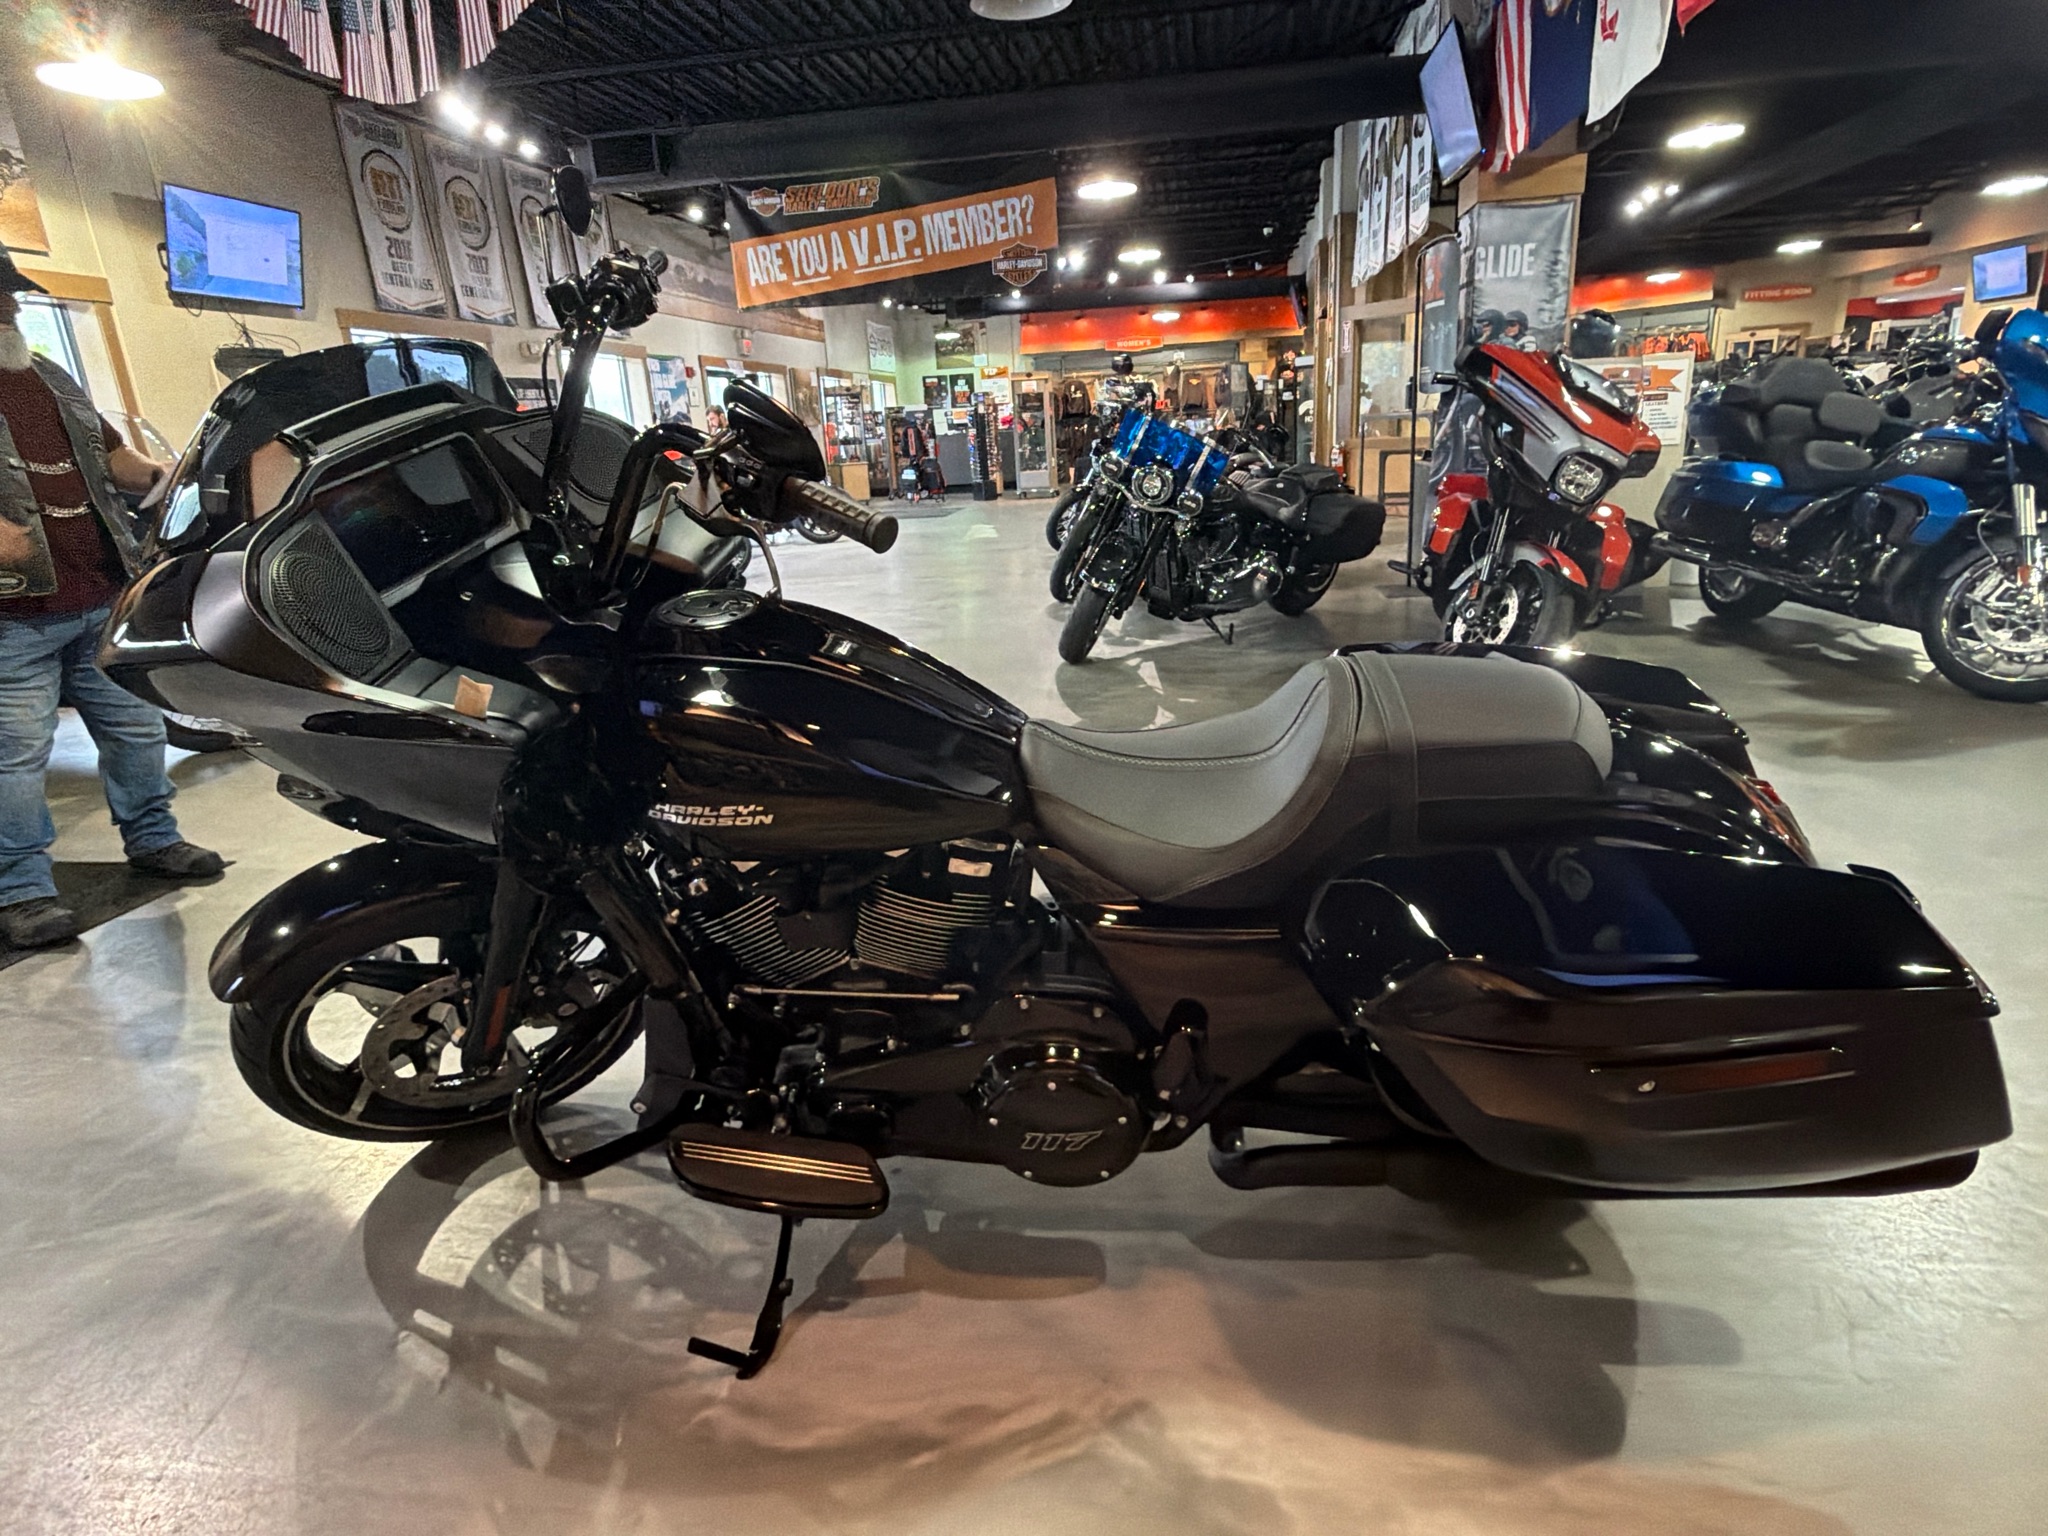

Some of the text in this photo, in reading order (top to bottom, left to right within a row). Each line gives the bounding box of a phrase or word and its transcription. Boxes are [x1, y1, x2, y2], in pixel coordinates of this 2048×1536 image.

[746, 194, 1035, 288] ARE YOU A V.I.P. MEMBER?
[1474, 242, 1538, 280] GLIDE
[1116, 339, 1151, 348] WOMEN'S
